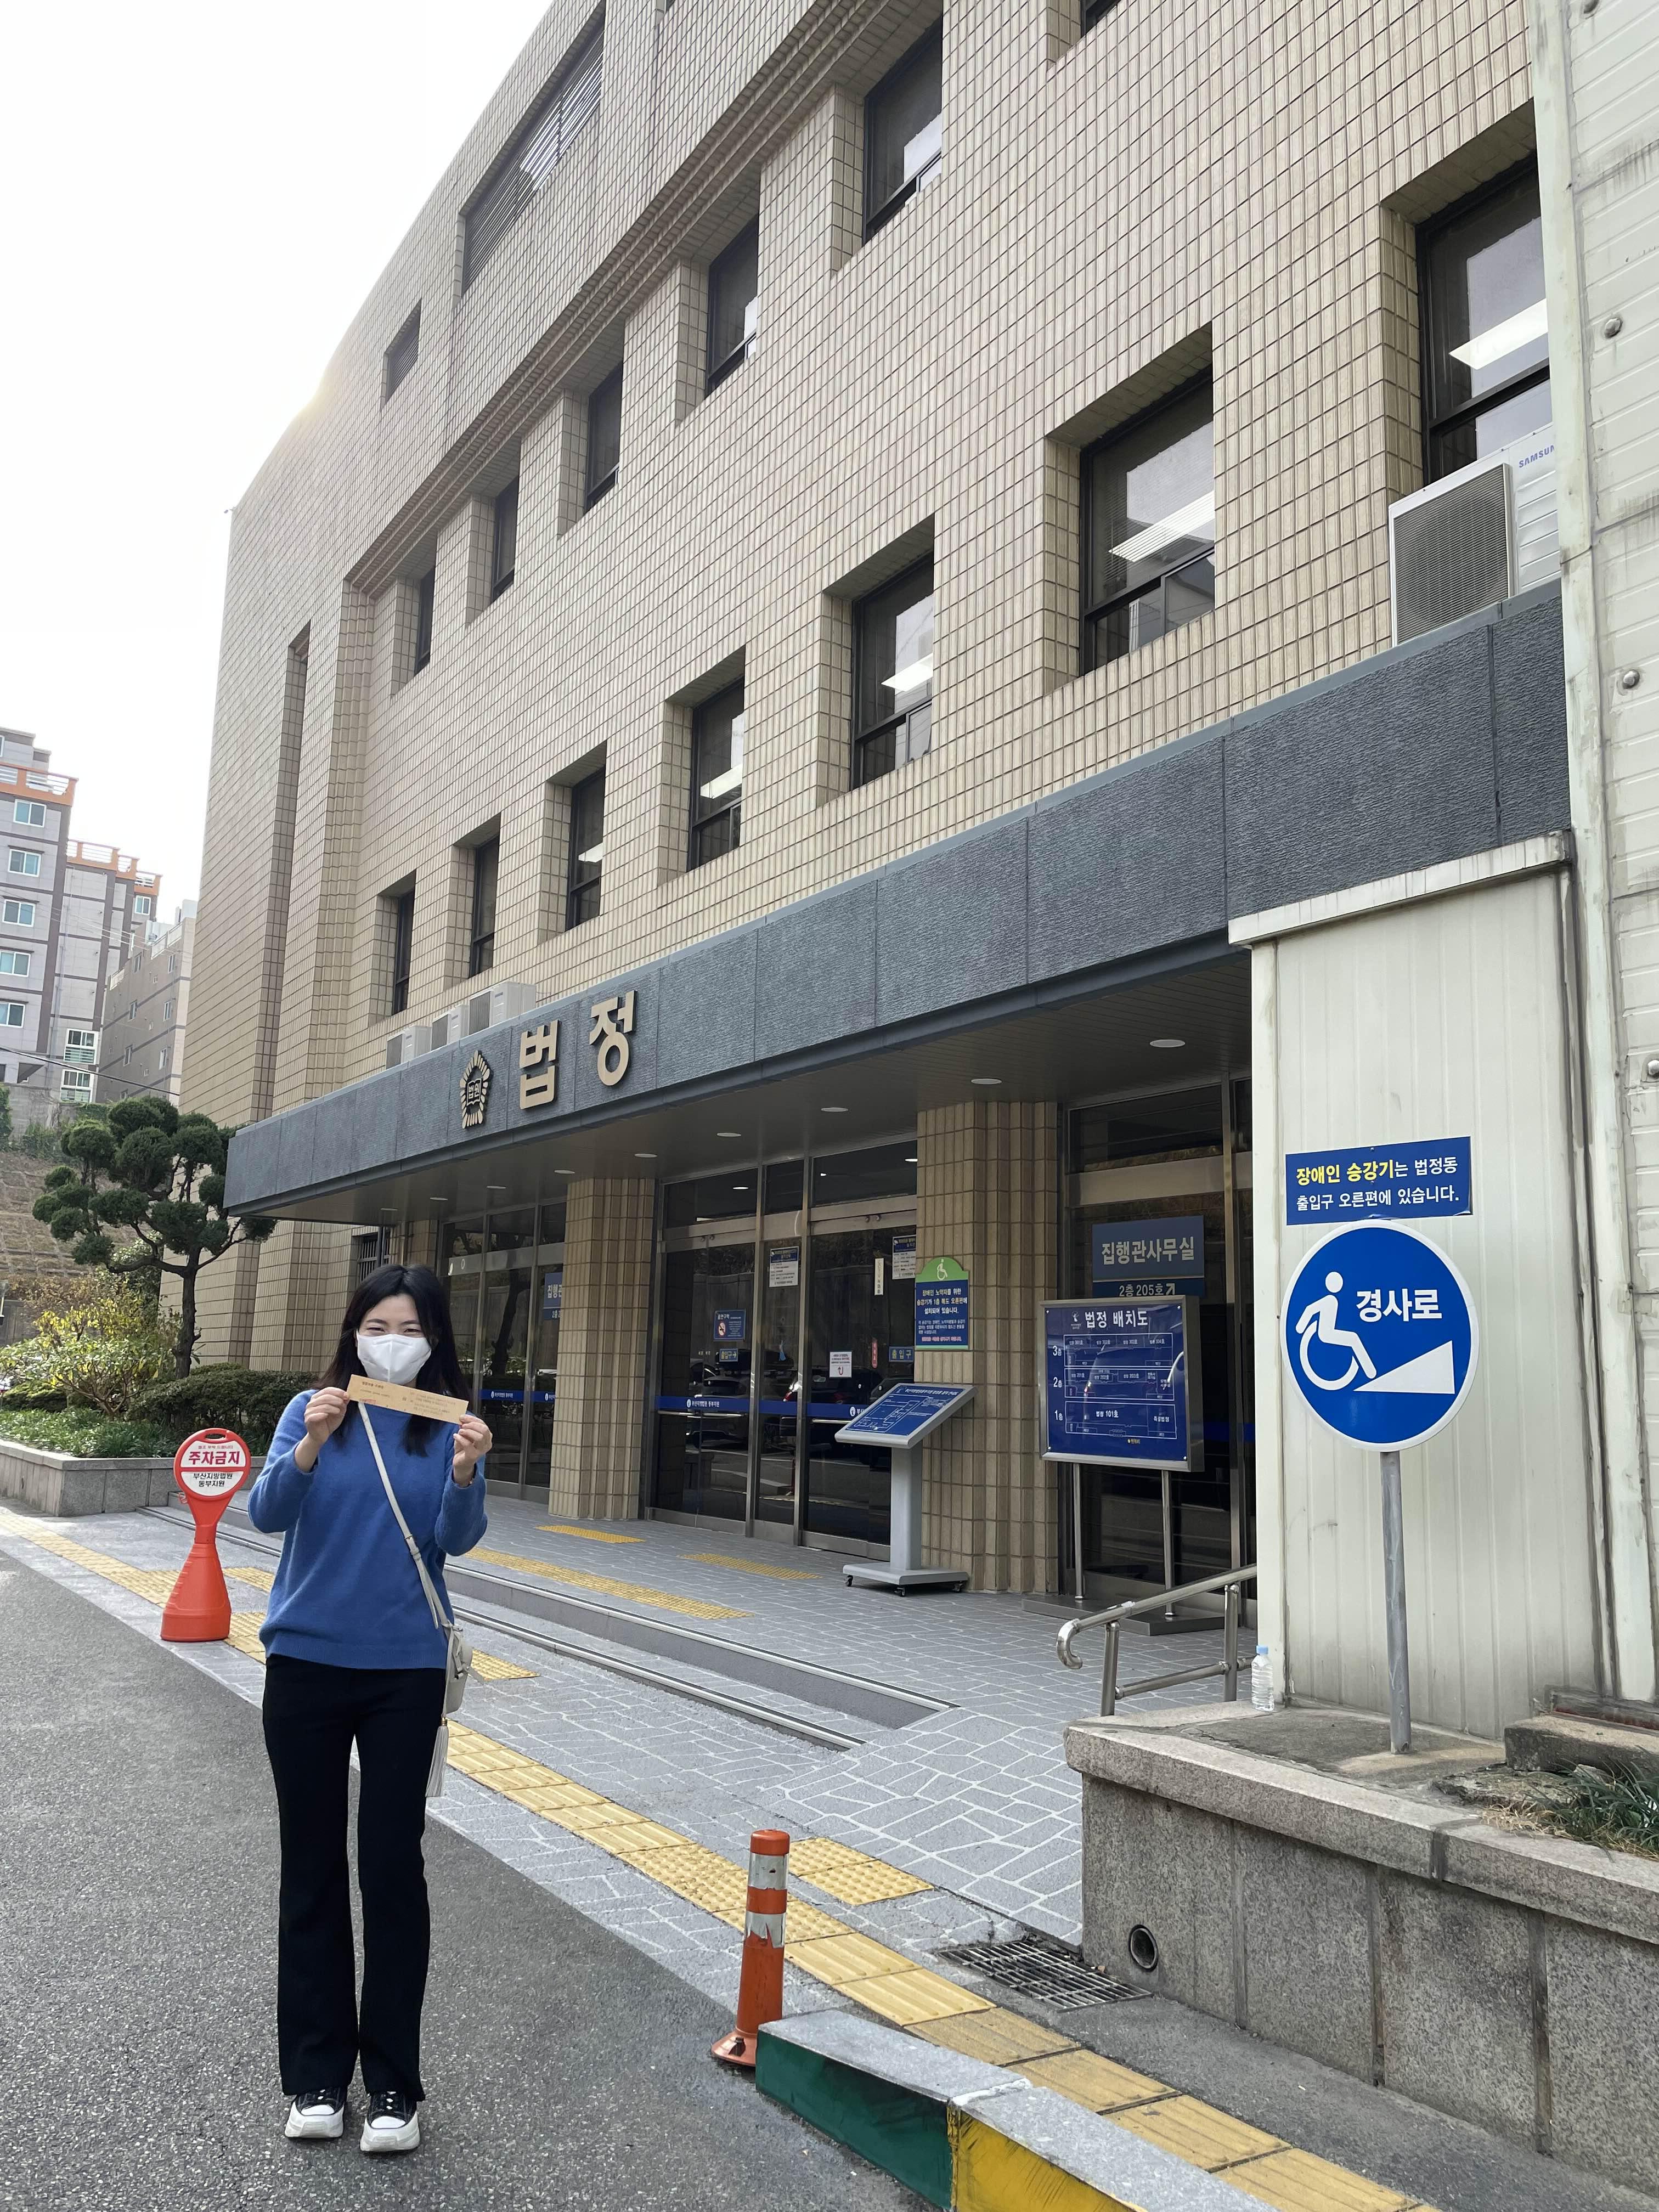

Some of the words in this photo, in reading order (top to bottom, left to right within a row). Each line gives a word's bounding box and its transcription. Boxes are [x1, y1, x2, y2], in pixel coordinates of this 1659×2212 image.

[519, 990, 637, 1110] 법정
[1296, 1164, 1340, 1186] 장애인
[1346, 1159, 1408, 1182] 승강기는
[1414, 1156, 1458, 1176] 법정동
[1296, 1194, 1334, 1211] 출입구
[1339, 1189, 1391, 1207] 오른편에
[1398, 1184, 1459, 1205] 있습니다.
[1102, 1236, 1194, 1265] 집행관사무실
[1119, 1284, 1134, 1297] 2층
[1136, 1283, 1164, 1296] 205호
[1085, 1310, 1107, 1328] 법정
[1113, 1310, 1148, 1328] 배치도
[1356, 1288, 1442, 1322] 경사로
[189, 1451, 240, 1465] 주차금지
